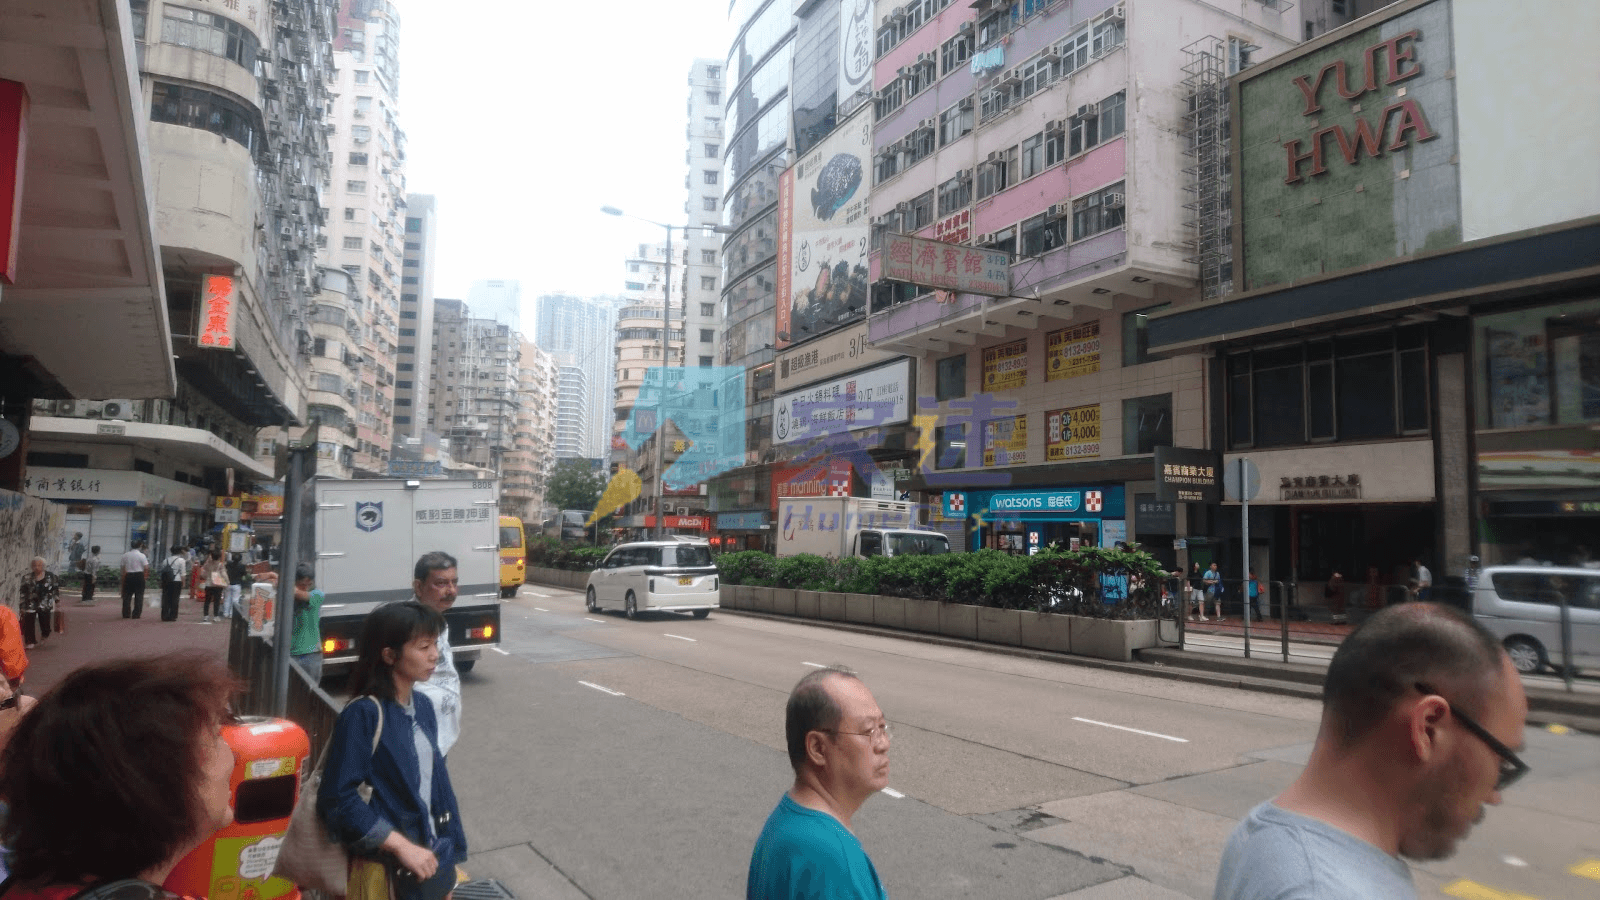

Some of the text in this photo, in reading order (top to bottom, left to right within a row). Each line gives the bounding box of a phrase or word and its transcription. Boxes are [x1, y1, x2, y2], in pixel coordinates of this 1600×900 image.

[1292, 29, 1424, 116] YUE
[1284, 98, 1440, 184] HWA
[889, 239, 984, 275] 經濟賓館
[1063, 339, 1100, 358] 8132-8909
[1073, 410, 1096, 426] 4,000
[1073, 425, 1096, 441] 4,000
[1065, 443, 1100, 456] 8132-8909
[1164, 475, 1215, 485] CHAMPION BUILDING
[995, 495, 1073, 508] watsons 屈臣氏
